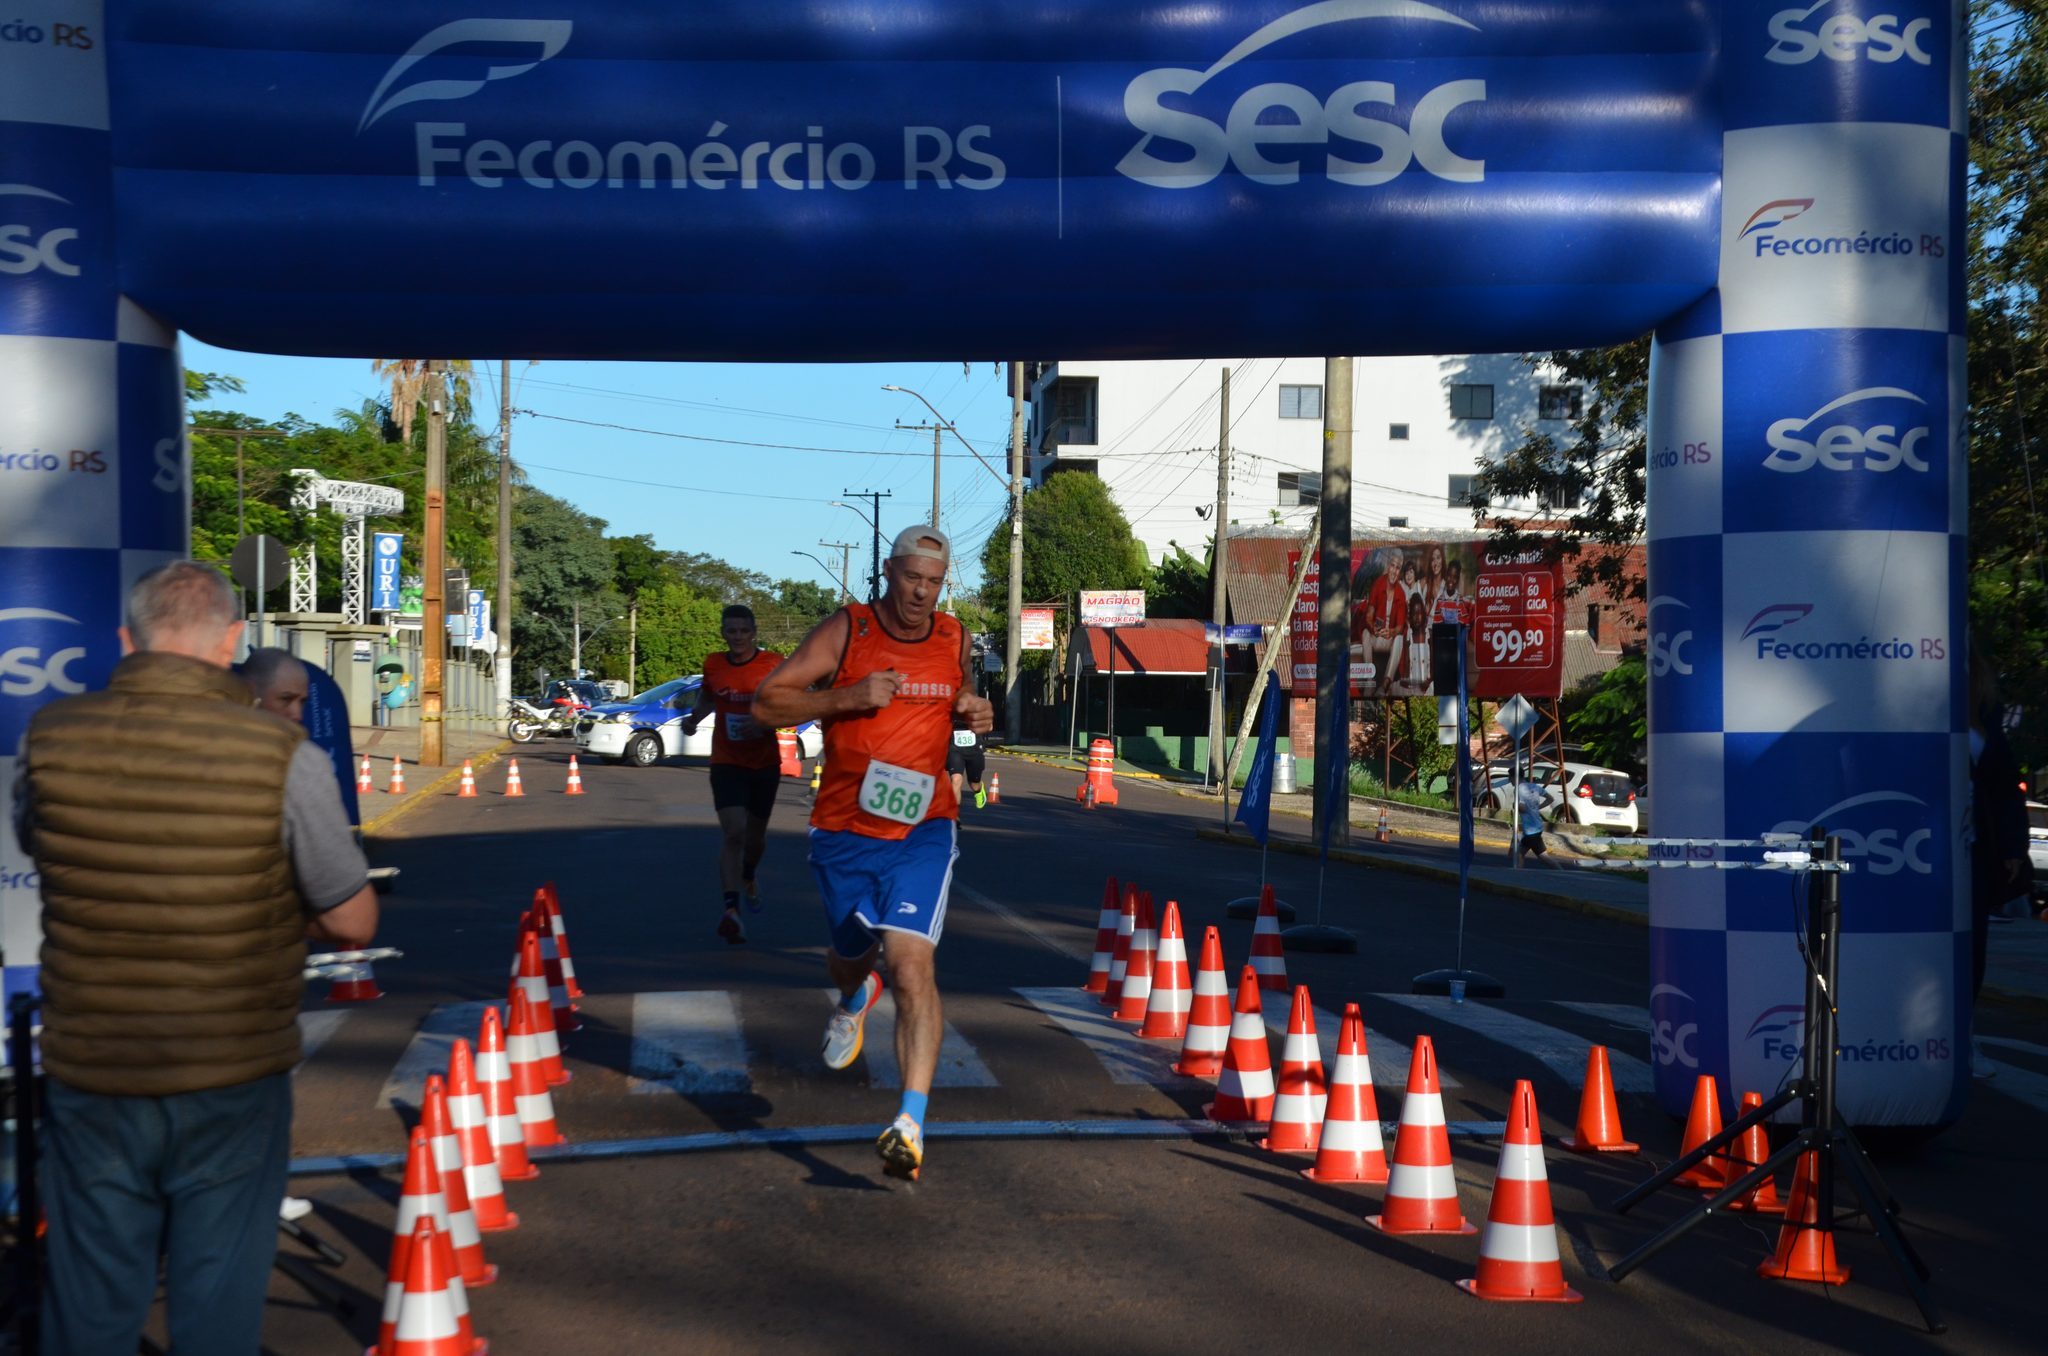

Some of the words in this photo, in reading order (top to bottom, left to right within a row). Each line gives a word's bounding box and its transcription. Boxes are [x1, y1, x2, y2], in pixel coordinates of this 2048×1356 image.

[53, 22, 93, 50] RS
[1764, 9, 1931, 65] Sesc
[1115, 67, 1487, 189] Sesc
[415, 121, 875, 190] Fecomércio
[904, 125, 1006, 190] RS
[1756, 230, 1913, 258] Fecomércio
[1920, 234, 1944, 258] RS
[1683, 442, 1712, 465] RS
[1762, 417, 1929, 473] Sesc
[69, 449, 107, 473] RS
[379, 558, 397, 608] URI
[1479, 586, 1495, 598] 600
[1496, 585, 1520, 597] MEGA
[1528, 584, 1539, 596] 60
[1527, 598, 1548, 610] GIGA
[1492, 629, 1544, 663] 99,90
[1757, 636, 1914, 660] Fecomércio
[1921, 638, 1945, 660] RS
[957, 736, 973, 745] 438
[868, 781, 923, 819] 368
[1763, 1038, 1919, 1062] Femércio
[1926, 1038, 1950, 1061] RS
